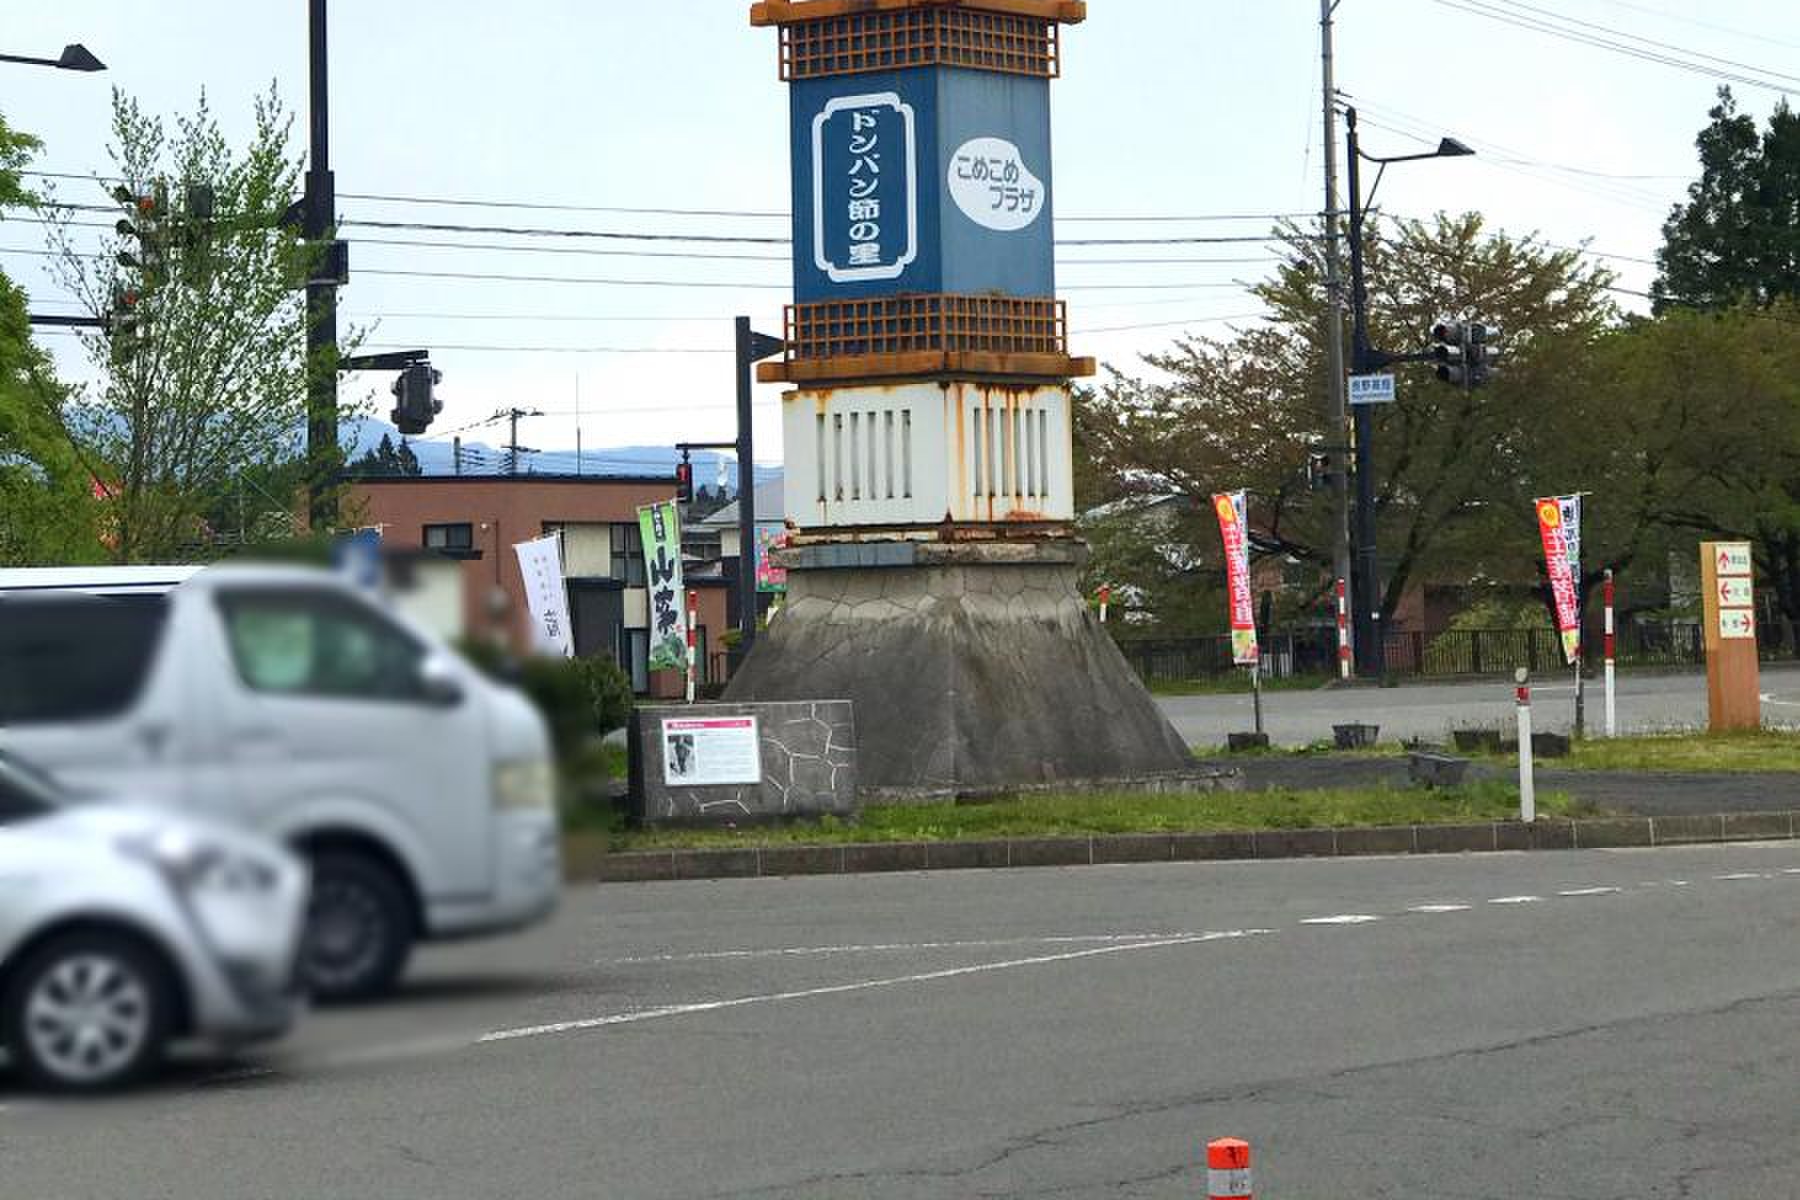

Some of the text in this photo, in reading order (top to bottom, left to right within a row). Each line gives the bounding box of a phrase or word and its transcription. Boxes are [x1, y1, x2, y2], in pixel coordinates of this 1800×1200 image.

[957, 156, 1020, 184] こめこめ
[989, 185, 1035, 213] プラザ
